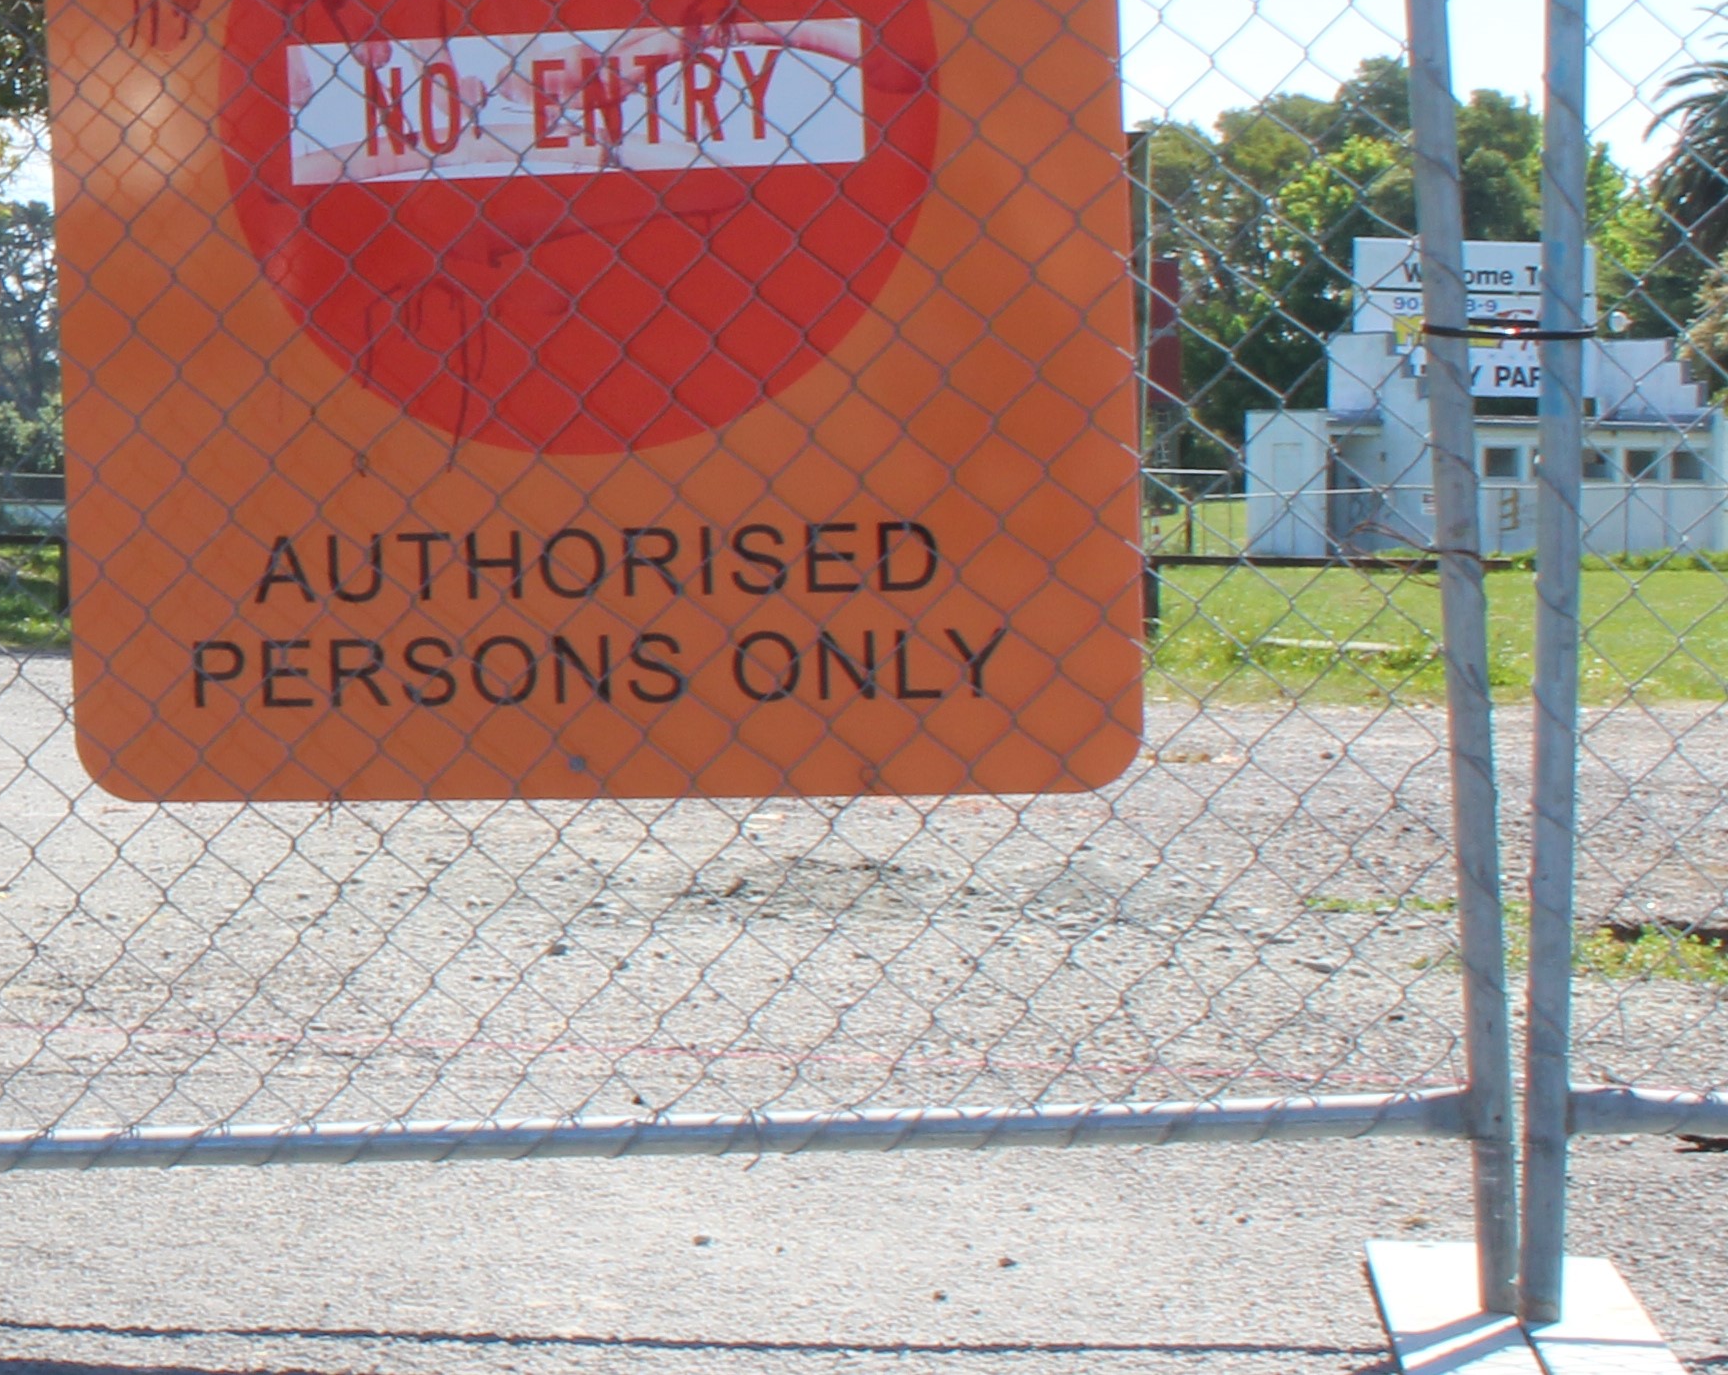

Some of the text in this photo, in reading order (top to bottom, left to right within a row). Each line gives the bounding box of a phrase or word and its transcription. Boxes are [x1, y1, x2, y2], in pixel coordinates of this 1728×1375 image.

[364, 48, 785, 160] NO ENTRY
[1403, 262, 1514, 286] Wome
[254, 520, 940, 605] AUTHORISED
[191, 627, 1008, 709] PERSONS ONLY
